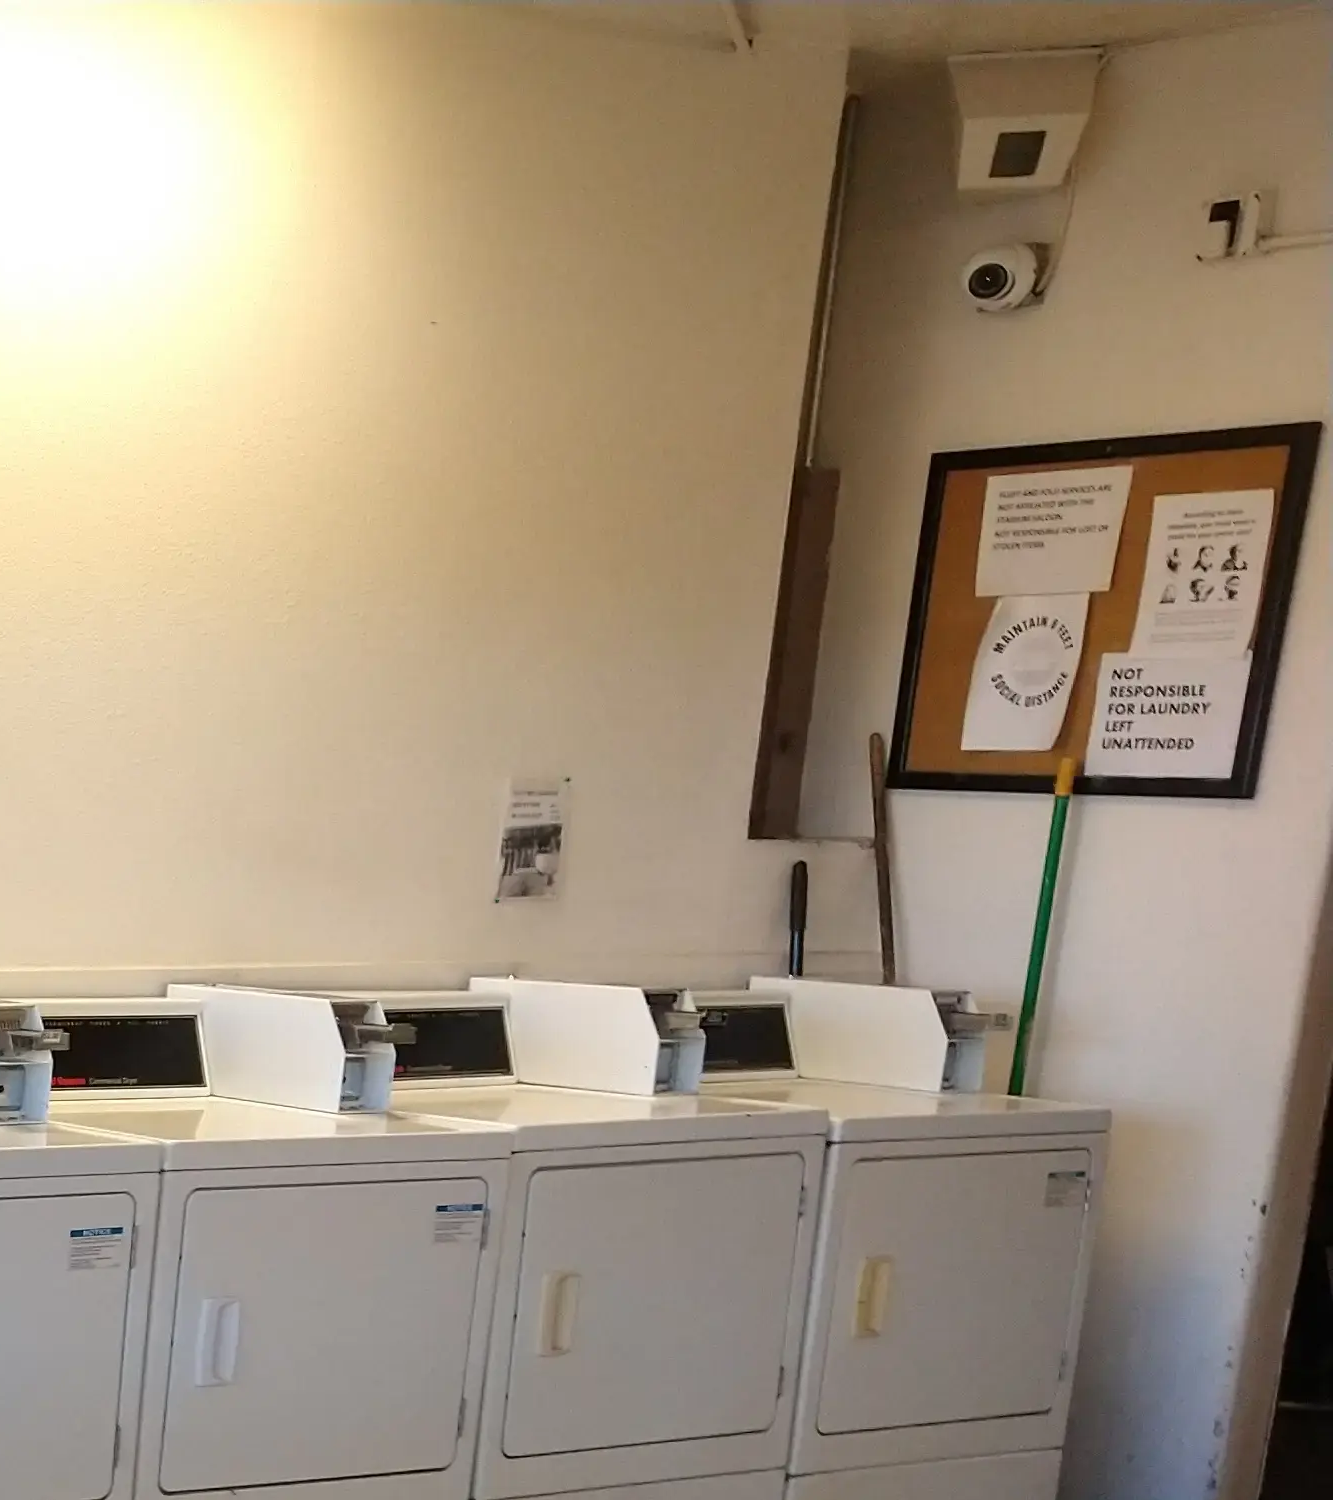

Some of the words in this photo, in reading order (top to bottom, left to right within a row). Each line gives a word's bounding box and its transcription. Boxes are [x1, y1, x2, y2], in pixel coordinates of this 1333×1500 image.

[993, 615, 1049, 654] MAINTAIN
[1057, 623, 1074, 650] FEET
[1111, 668, 1144, 680] NOT
[991, 673, 1022, 706] SOCIAL
[1024, 671, 1069, 708] DISTANCE
[1109, 684, 1207, 698] RESPONSIBLE
[1107, 703, 1136, 715] FOR
[1140, 702, 1212, 715] LAUNDRY
[1104, 720, 1135, 733] LEFT
[1101, 737, 1195, 750] UNATTENDED
